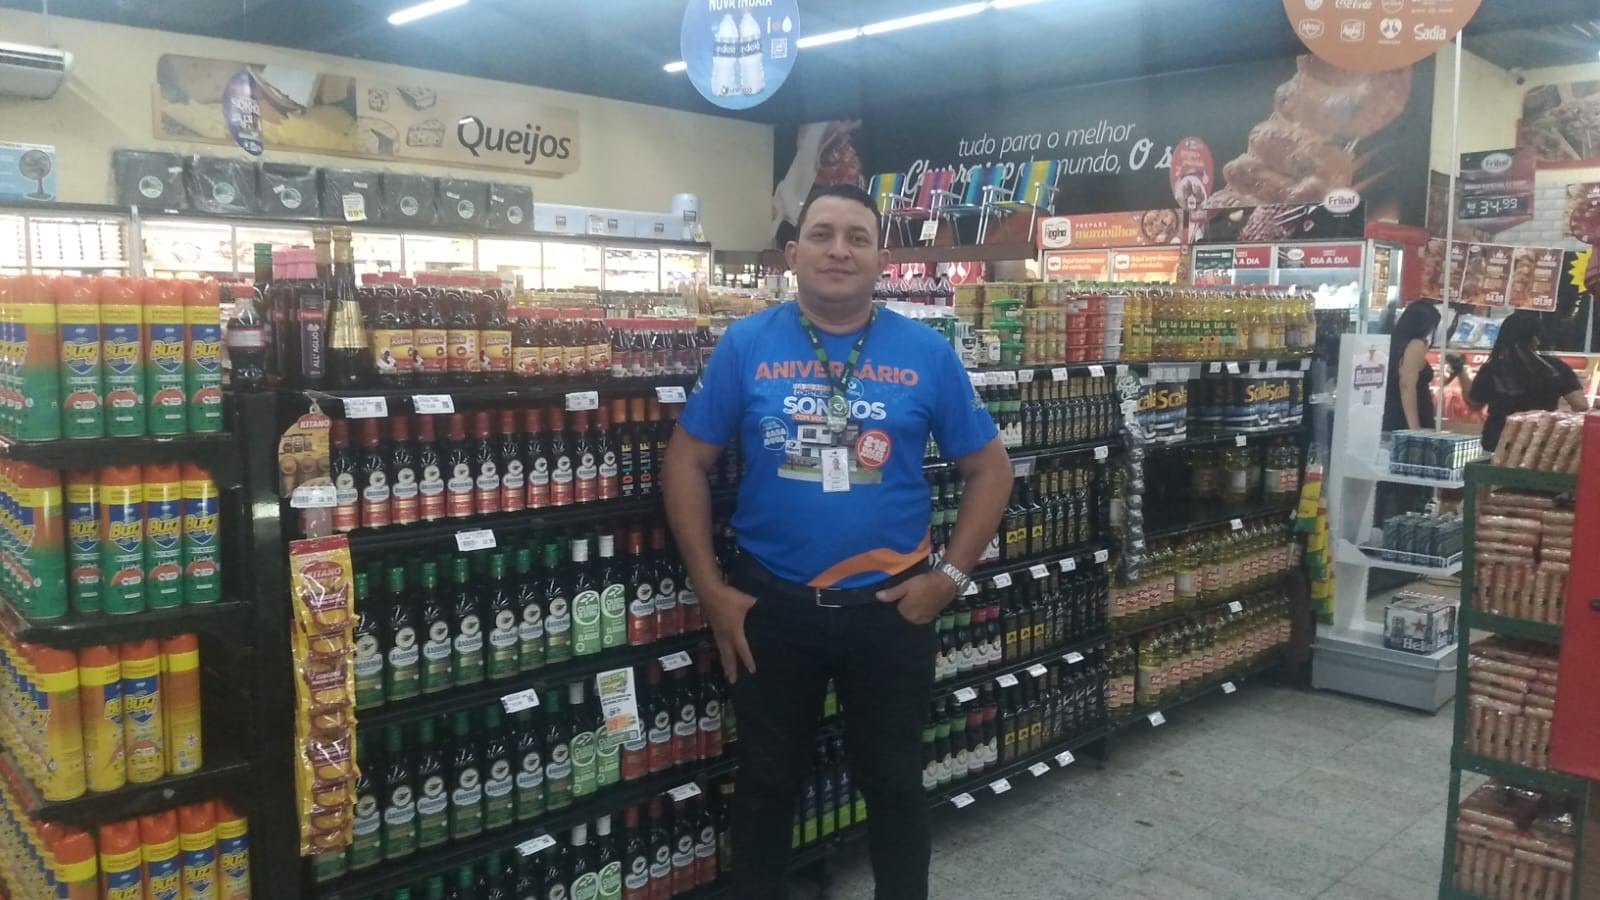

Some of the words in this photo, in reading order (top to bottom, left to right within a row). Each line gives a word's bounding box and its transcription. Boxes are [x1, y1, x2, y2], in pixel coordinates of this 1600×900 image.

[1413, 23, 1447, 41] Sadia
[457, 115, 571, 165] Queijos
[958, 133, 996, 157] tudo
[1000, 133, 1041, 158] para
[1047, 134, 1060, 149] o
[1065, 120, 1136, 147] melhor
[1128, 138, 1153, 171] O
[1328, 195, 1356, 206] Fribal
[1075, 224, 1138, 240] maravilhas
[1246, 257, 1260, 265] DIA
[1310, 257, 1324, 265] DIA
[1334, 257, 1349, 265] DIA
[755, 359, 919, 386] ANIVERÁRIO
[782, 396, 887, 420] SONOS
[300, 419, 330, 429] KITANO
